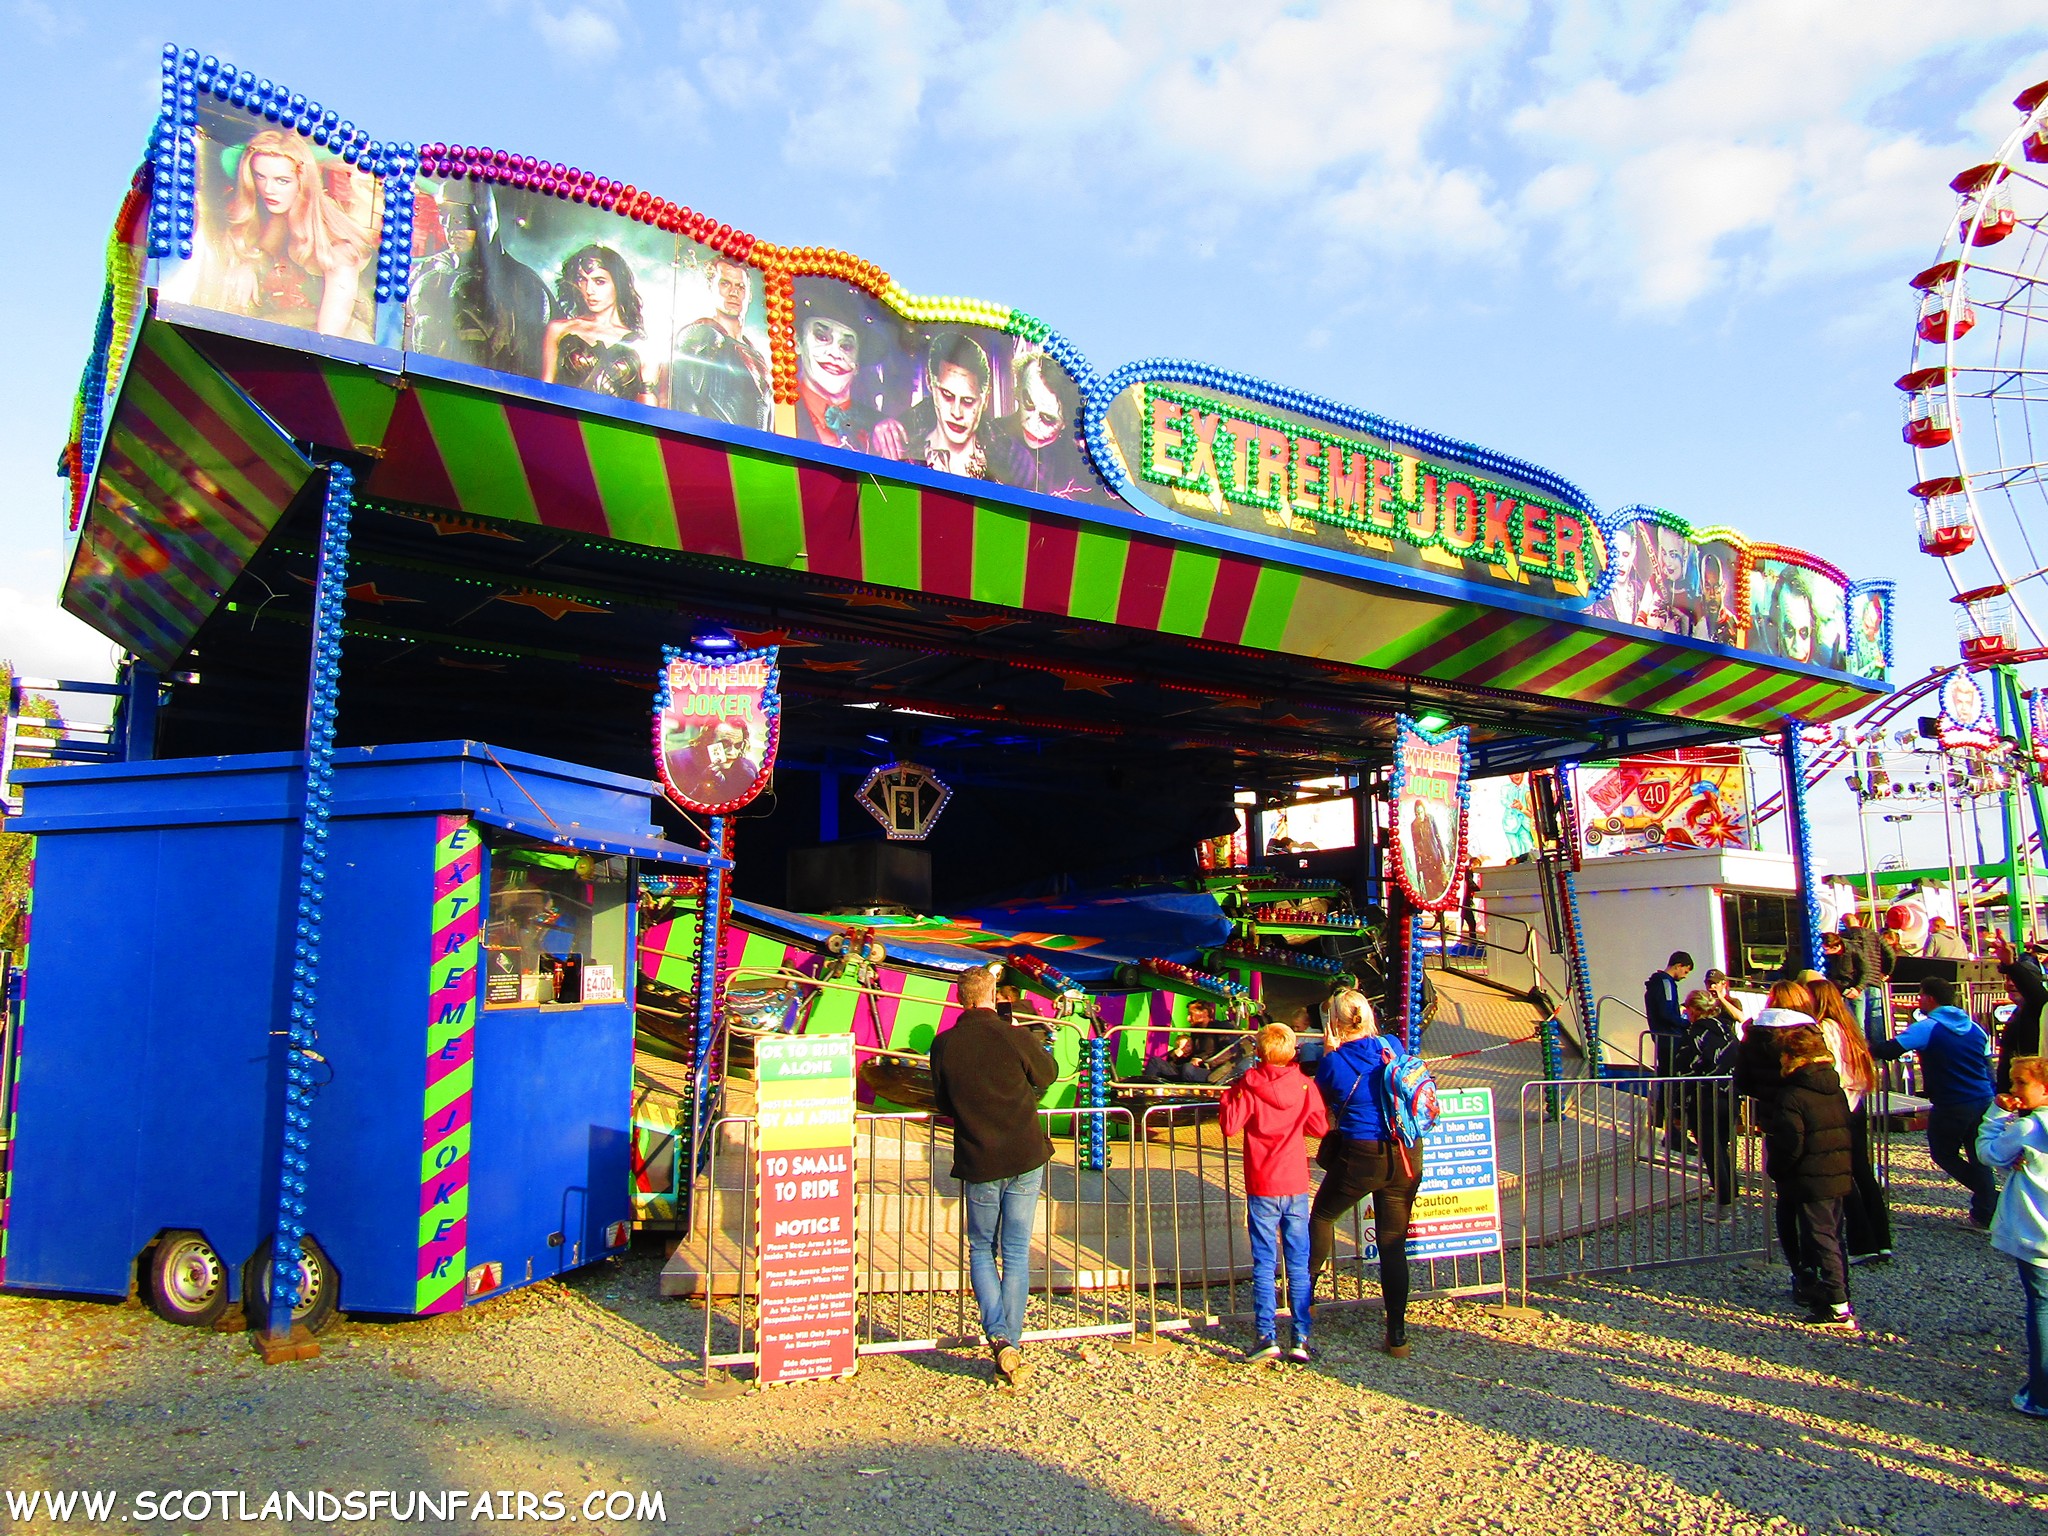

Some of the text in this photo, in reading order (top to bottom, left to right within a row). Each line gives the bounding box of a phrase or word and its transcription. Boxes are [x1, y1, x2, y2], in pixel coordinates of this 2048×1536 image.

[1142, 382, 1595, 591] EXTREME JOKER
[669, 663, 771, 690] EXTREME
[682, 693, 753, 722] JOKER
[1402, 745, 1461, 775] EXTREME
[1406, 775, 1450, 805] JOKER
[1643, 784, 1665, 805] 40
[592, 968, 606, 976] FARE
[586, 976, 612, 992] £4.00
[430, 828, 470, 1279] EXTREME JOKER
[761, 1042, 848, 1059] OK TO RIDE
[778, 1060, 832, 1075] ALONE
[762, 1109, 850, 1128] BY AN ADULT
[1446, 1122, 1465, 1132] blue
[1467, 1120, 1484, 1130] line
[1434, 1136, 1442, 1144] is
[1445, 1134, 1453, 1143] in
[1455, 1132, 1486, 1143] motion
[1437, 1151, 1453, 1160] legs
[1454, 1149, 1476, 1158] inside
[766, 1154, 847, 1177] TO SMALL
[1436, 1166, 1454, 1176] ride
[1457, 1164, 1482, 1175] stops
[1451, 1179, 1463, 1187] on
[1465, 1177, 1476, 1185] or
[1478, 1174, 1491, 1183] off
[775, 1179, 839, 1202] TO RIDE
[1414, 1194, 1459, 1208] Caution
[1423, 1208, 1451, 1217] surface
[1454, 1206, 1473, 1214] when
[1475, 1204, 1488, 1212] wet
[775, 1216, 840, 1237] NOTICE
[1407, 1226, 1426, 1235] oking
[1439, 1222, 1463, 1231] alcohol
[1474, 1220, 1492, 1228] drugs
[767, 1243, 788, 1252] Please
[790, 1241, 806, 1250] Keep
[807, 1240, 825, 1248] Arms
[833, 1238, 848, 1247] Legs
[1404, 1243, 1424, 1252] uables
[764, 1252, 784, 1260] Inside
[785, 1251, 797, 1259] The
[798, 1250, 810, 1258] Car
[822, 1248, 831, 1256] All
[833, 1247, 851, 1255] Times
[766, 1265, 849, 1279] Please Be Aware Surfaces
[770, 1280, 783, 1288] Are
[784, 1278, 811, 1287] Slippery
[832, 1274, 845, 1282] Wet
[763, 1292, 852, 1306] Please Secure All Valuables
[769, 1301, 846, 1315] As We Can Not Be Held
[763, 1309, 851, 1325] Responsible For Any Losses
[766, 1334, 777, 1342] The
[779, 1333, 794, 1341] Ride
[795, 1331, 808, 1339] Will
[809, 1330, 825, 1339] Only
[826, 1329, 841, 1337] Stop
[796, 1339, 831, 1349] Emergency
[783, 1357, 832, 1368] Ride Operators
[779, 1369, 807, 1377] Decision
[816, 1365, 832, 1373] Final
